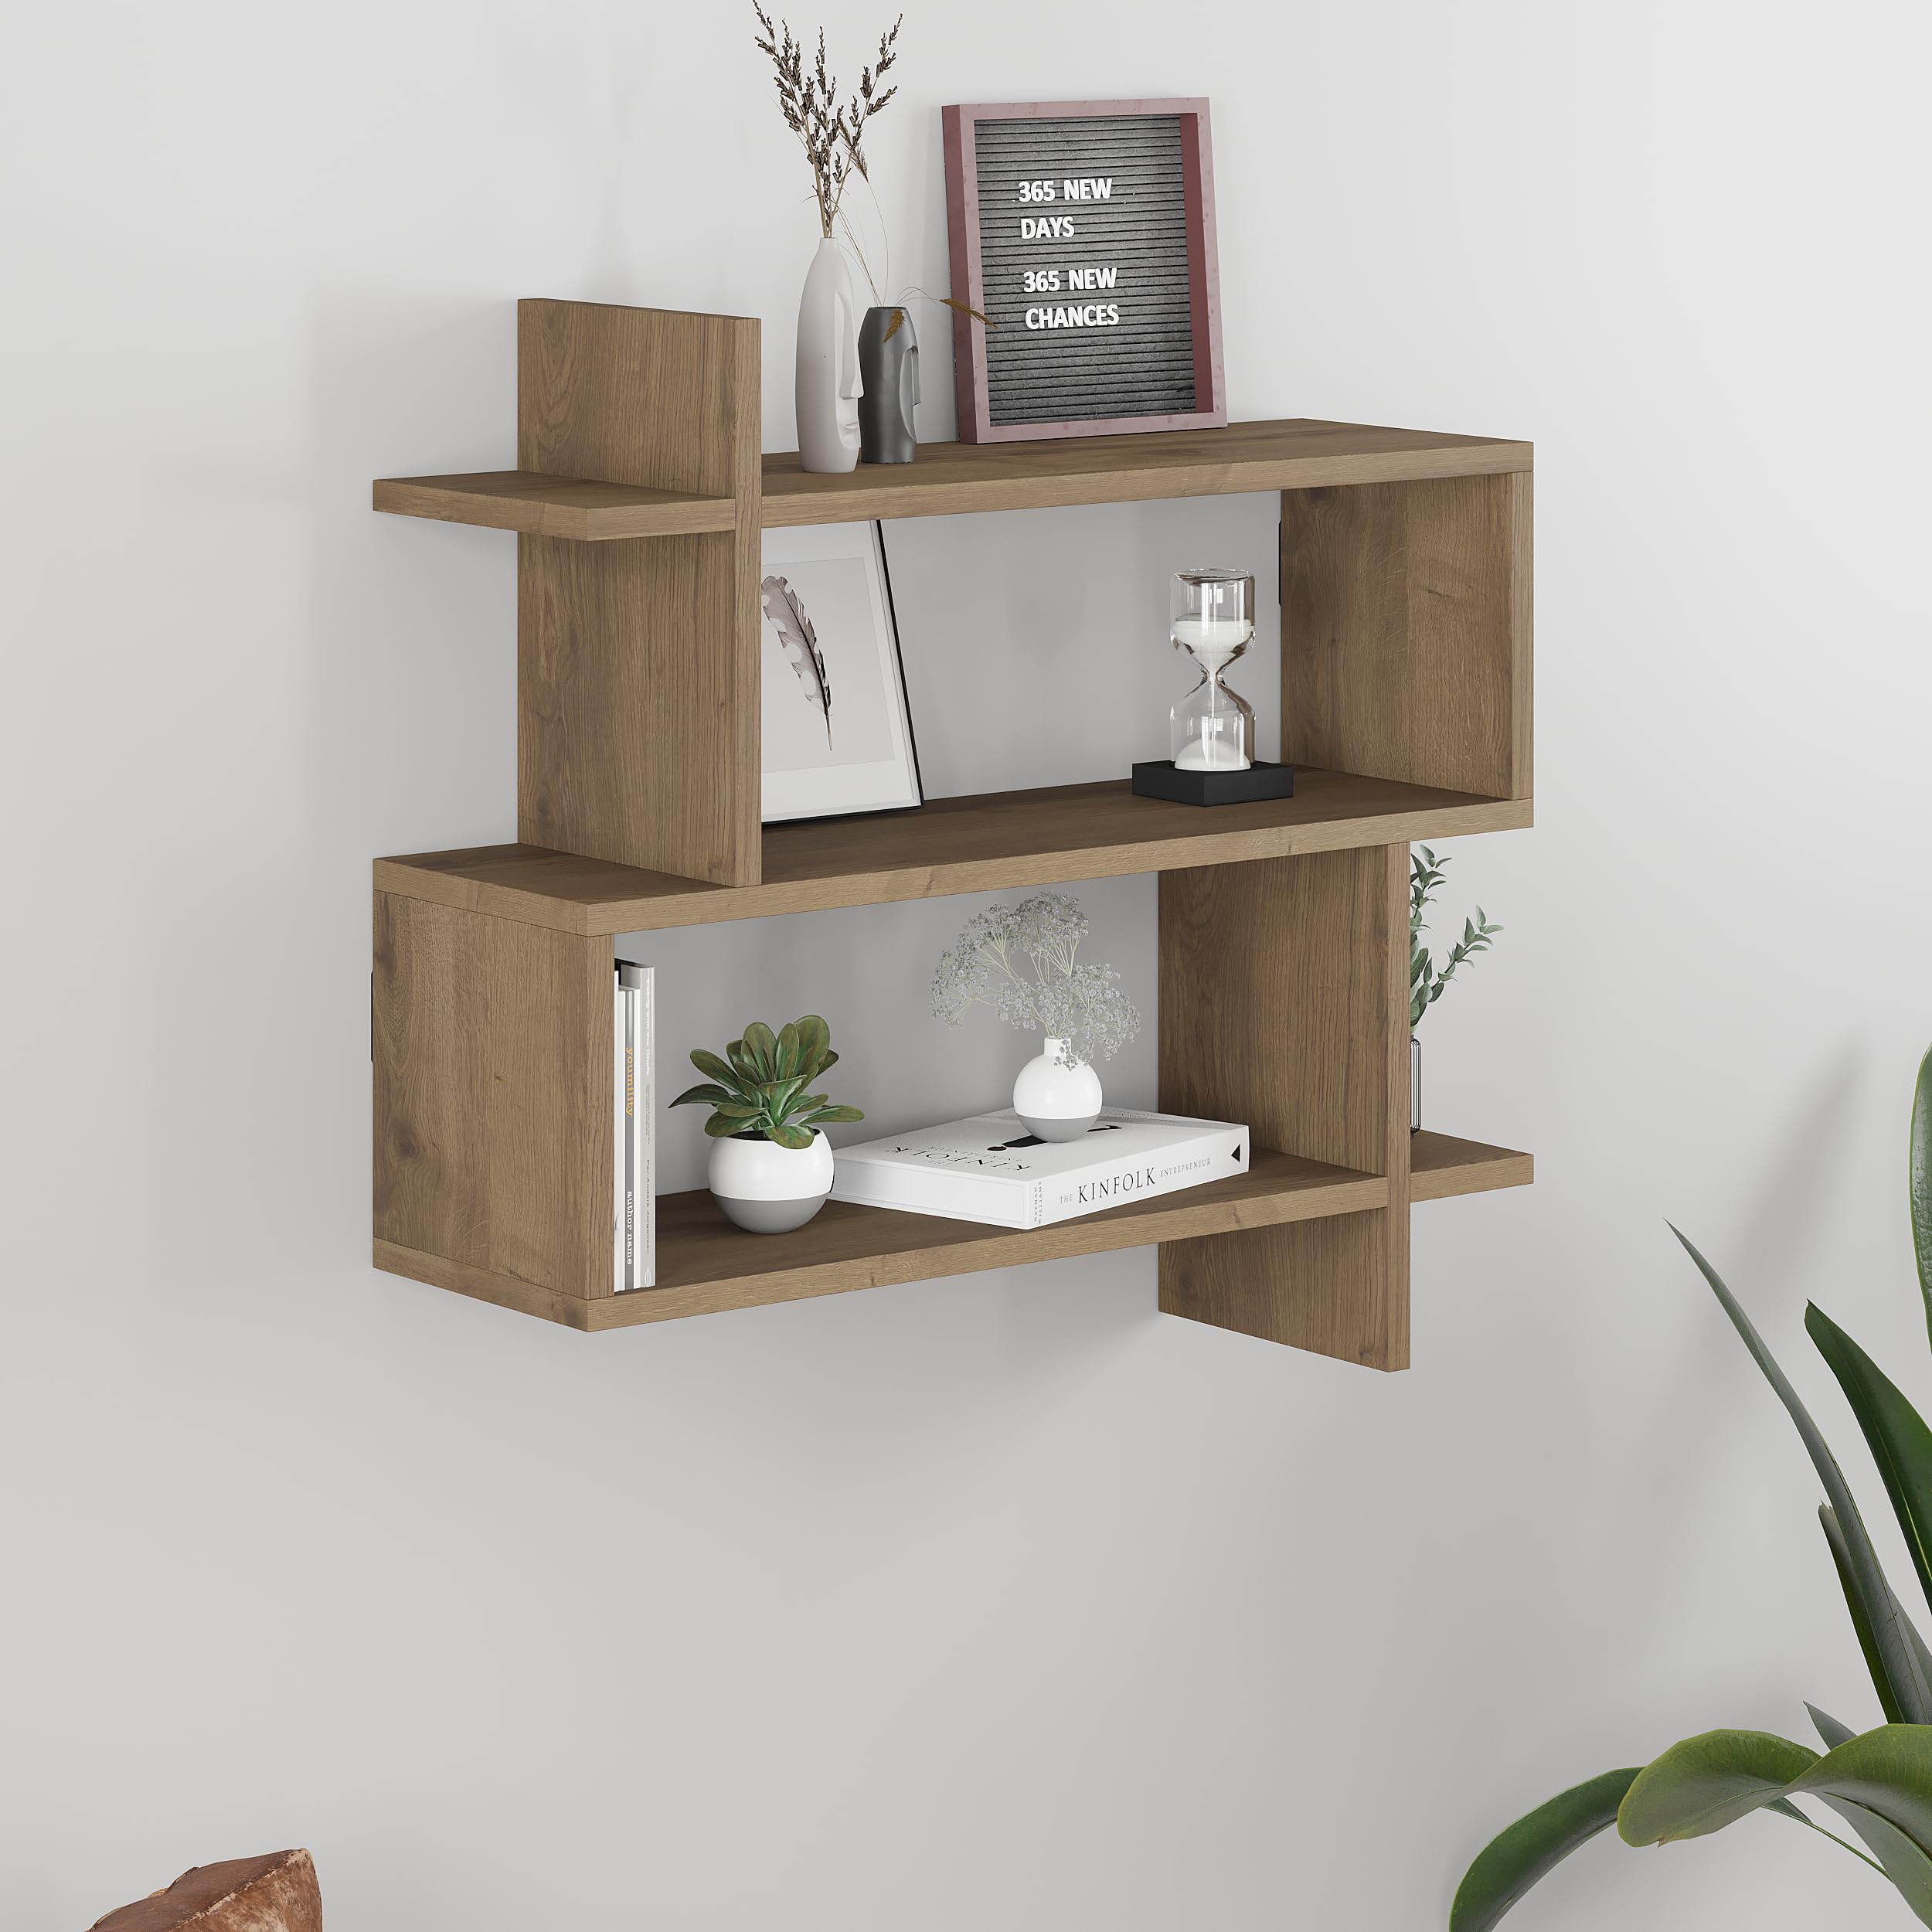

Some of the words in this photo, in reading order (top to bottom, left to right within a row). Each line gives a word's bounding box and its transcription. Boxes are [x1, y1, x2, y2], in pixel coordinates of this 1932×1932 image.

[1018, 180, 1056, 202] 365
[1063, 178, 1113, 200] NEW
[1020, 216, 1075, 239] DAYS
[1023, 270, 1060, 292] 365
[1068, 267, 1117, 291] NEW
[1025, 304, 1120, 329] CHANCES
[625, 1046, 634, 1117] youmility
[884, 1146, 1032, 1171] KINFOLK
[1059, 1193, 1073, 1204] THE
[1077, 1167, 1156, 1203] KINFOLK
[1160, 1158, 1211, 1178] ENTREPRENEUR
